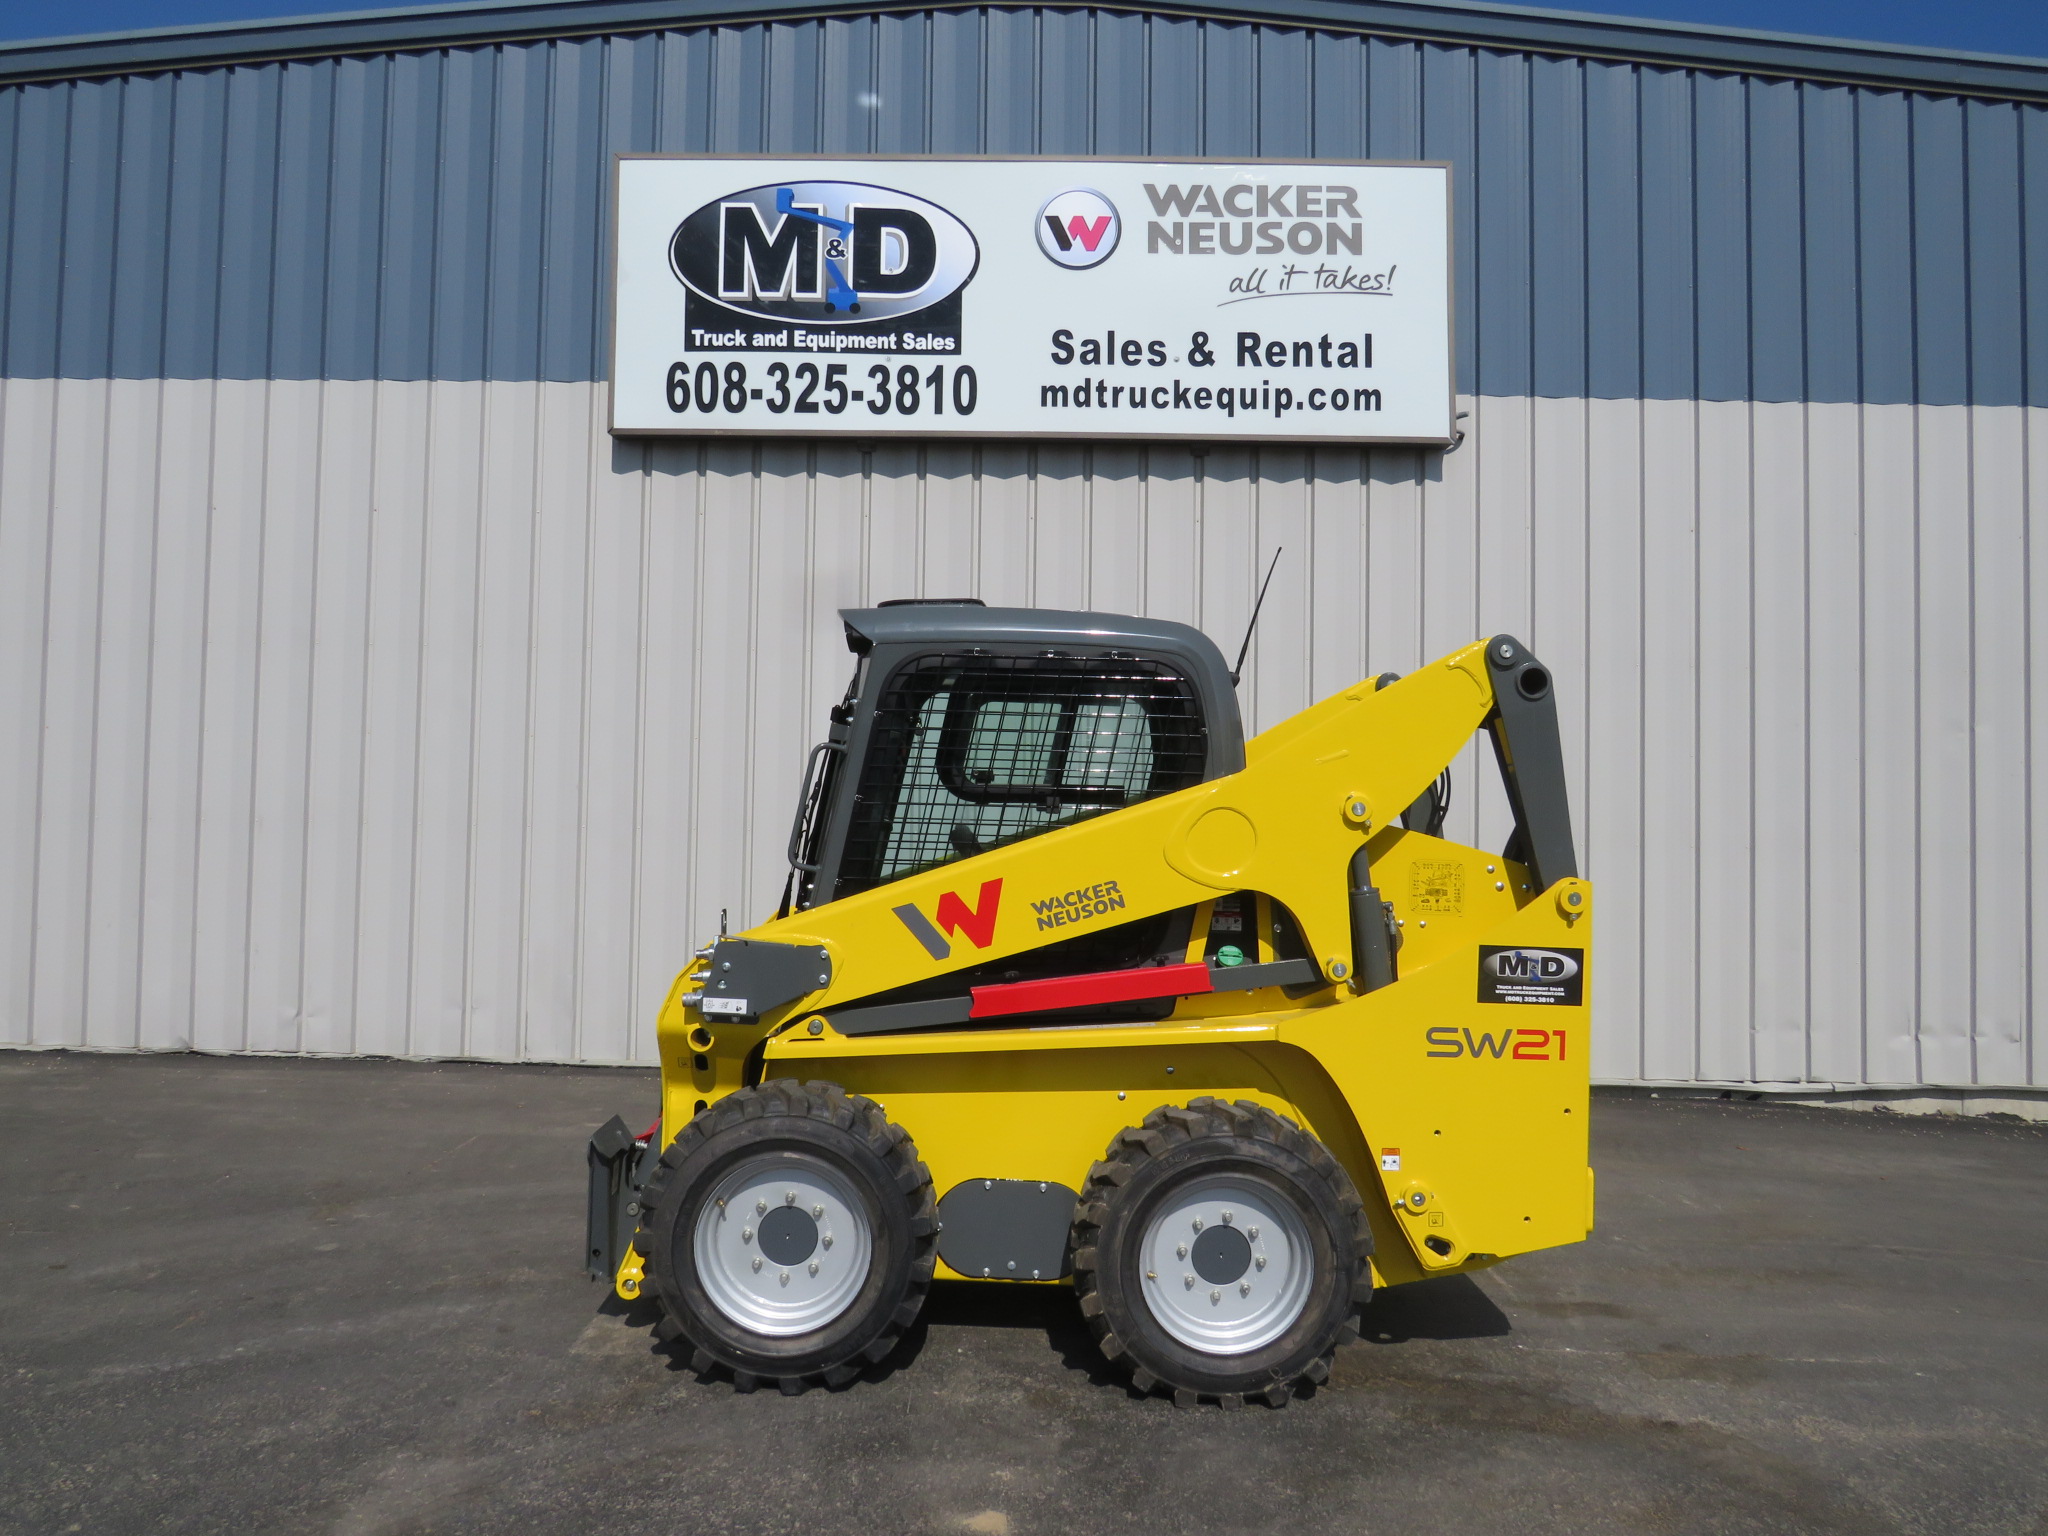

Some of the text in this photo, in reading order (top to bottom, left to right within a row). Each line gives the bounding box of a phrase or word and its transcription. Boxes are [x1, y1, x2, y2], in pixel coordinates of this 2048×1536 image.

[1142, 183, 1363, 218] WACKER
[1146, 220, 1363, 256] NEUSON
[1228, 263, 1397, 295] all it takes!
[691, 329, 956, 352] Truck and Equipment Sales
[1051, 329, 1373, 368] Sales & Rental
[666, 361, 978, 416] 608-325-3810
[1040, 377, 1382, 418] mdtruckequip.com
[1030, 880, 1121, 915] WACKER
[1036, 894, 1126, 931] NEUSON
[1425, 1026, 1567, 1061] SW21
